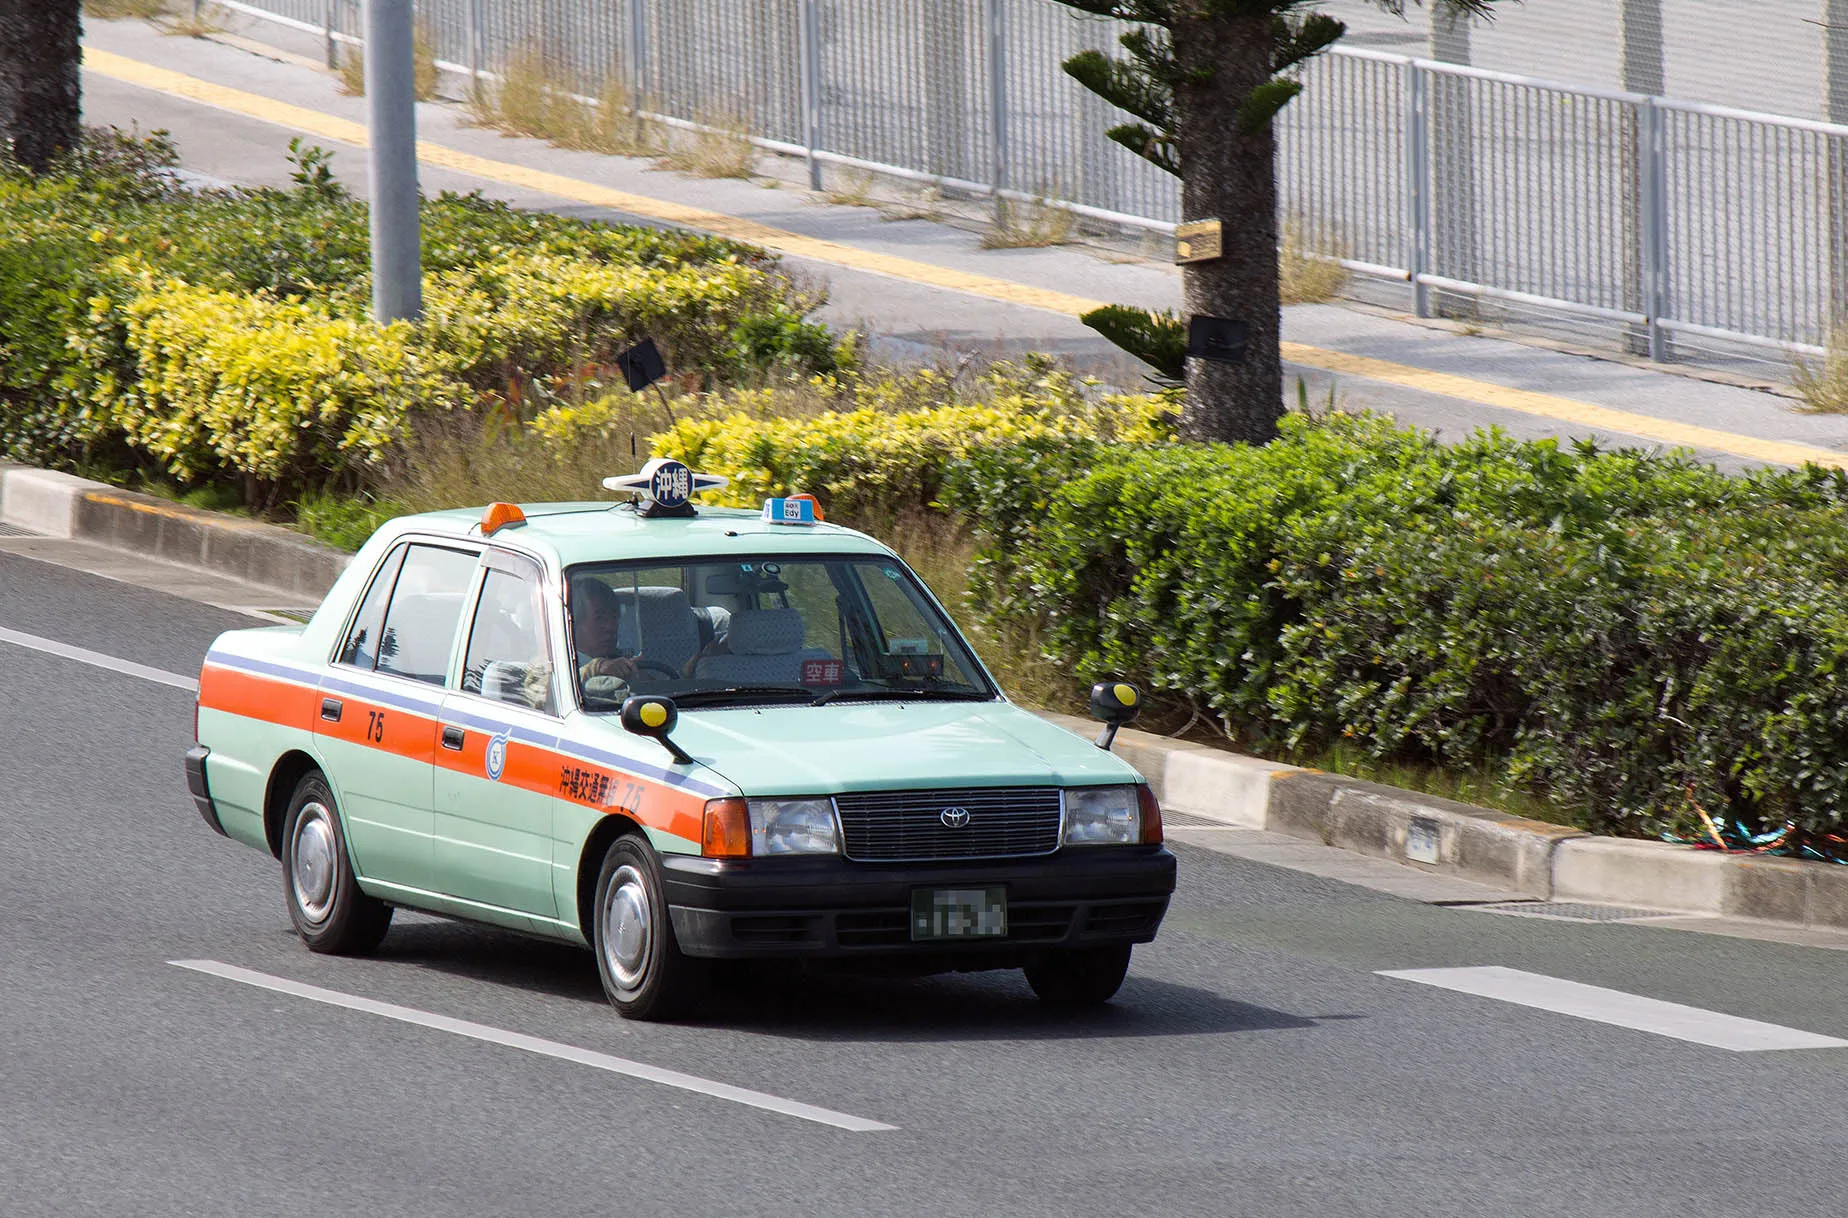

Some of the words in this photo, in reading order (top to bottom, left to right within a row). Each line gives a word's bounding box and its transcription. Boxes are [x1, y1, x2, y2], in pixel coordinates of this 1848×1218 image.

[656, 467, 689, 500] 沖縄
[785, 510, 799, 518] Edy
[805, 662, 841, 682] 空車
[367, 711, 385, 742] 75
[620, 783, 645, 814] 75
